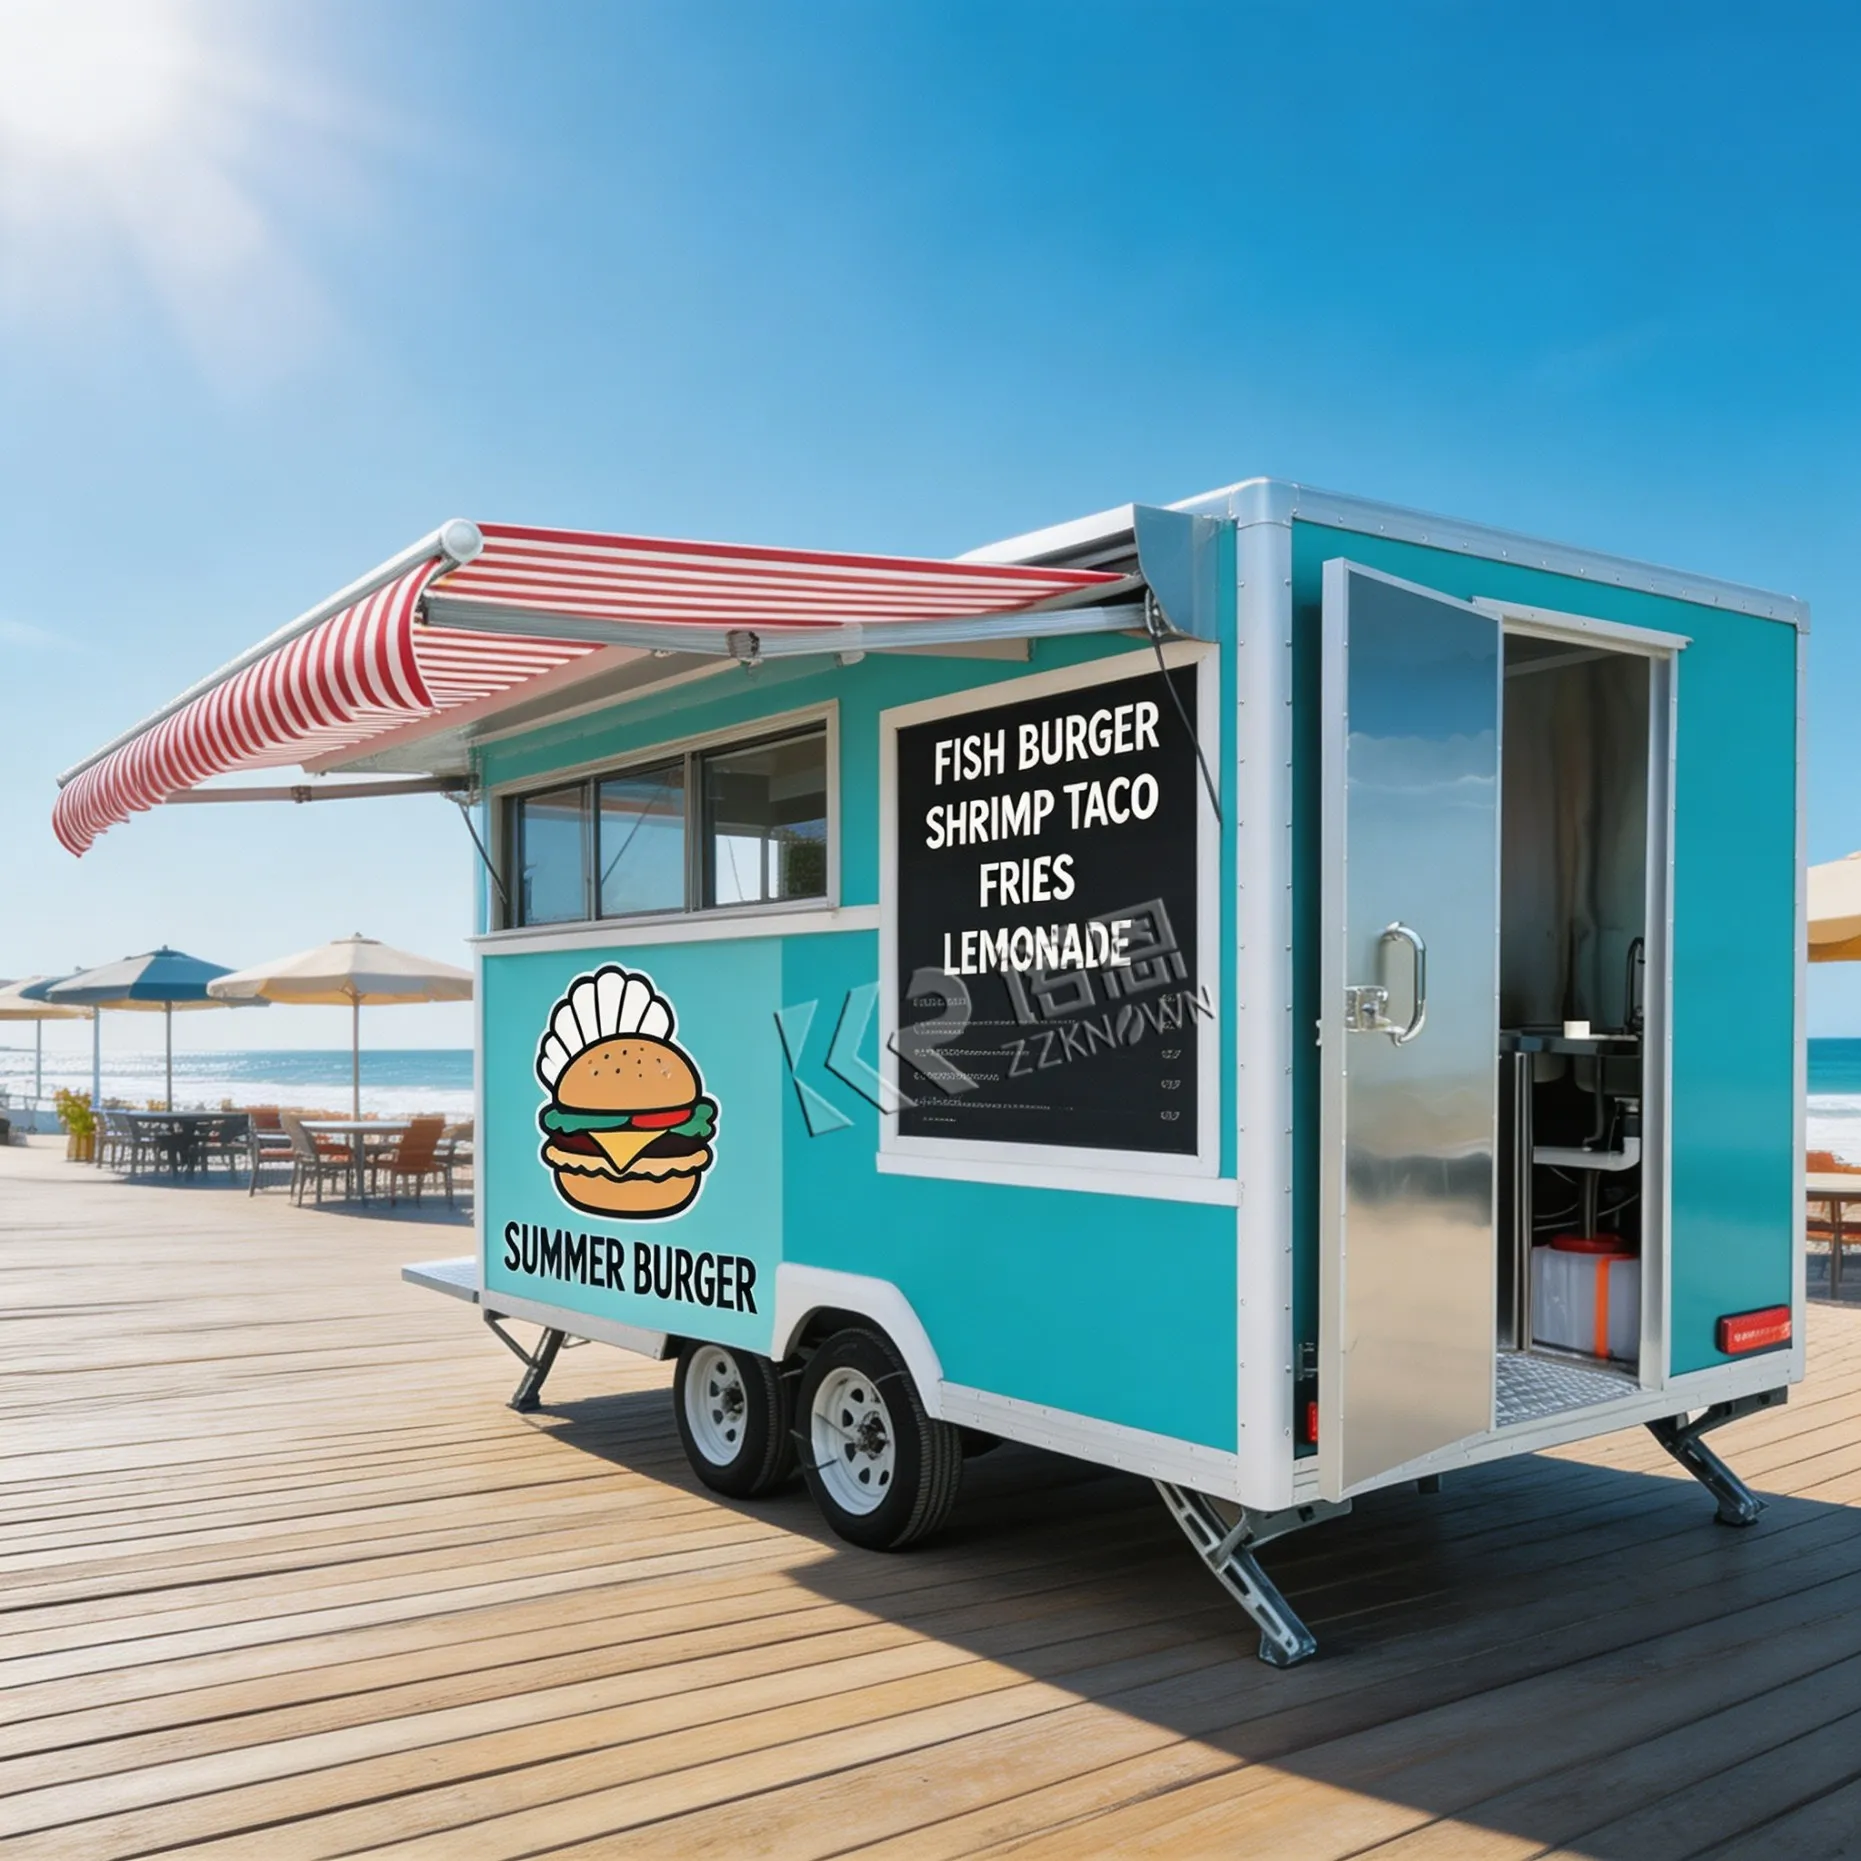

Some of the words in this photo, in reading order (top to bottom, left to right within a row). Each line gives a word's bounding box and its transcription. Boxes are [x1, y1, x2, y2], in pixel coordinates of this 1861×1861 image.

[934, 728, 1005, 786] FISH
[1018, 700, 1160, 771] BURGER
[925, 788, 1055, 850] SHRIMP
[1062, 773, 1159, 830] TACO
[980, 853, 1076, 908] FRIES
[943, 919, 1133, 977] LEMONADE
[503, 1220, 626, 1292] SUMMER
[633, 1241, 759, 1315] BURGER
